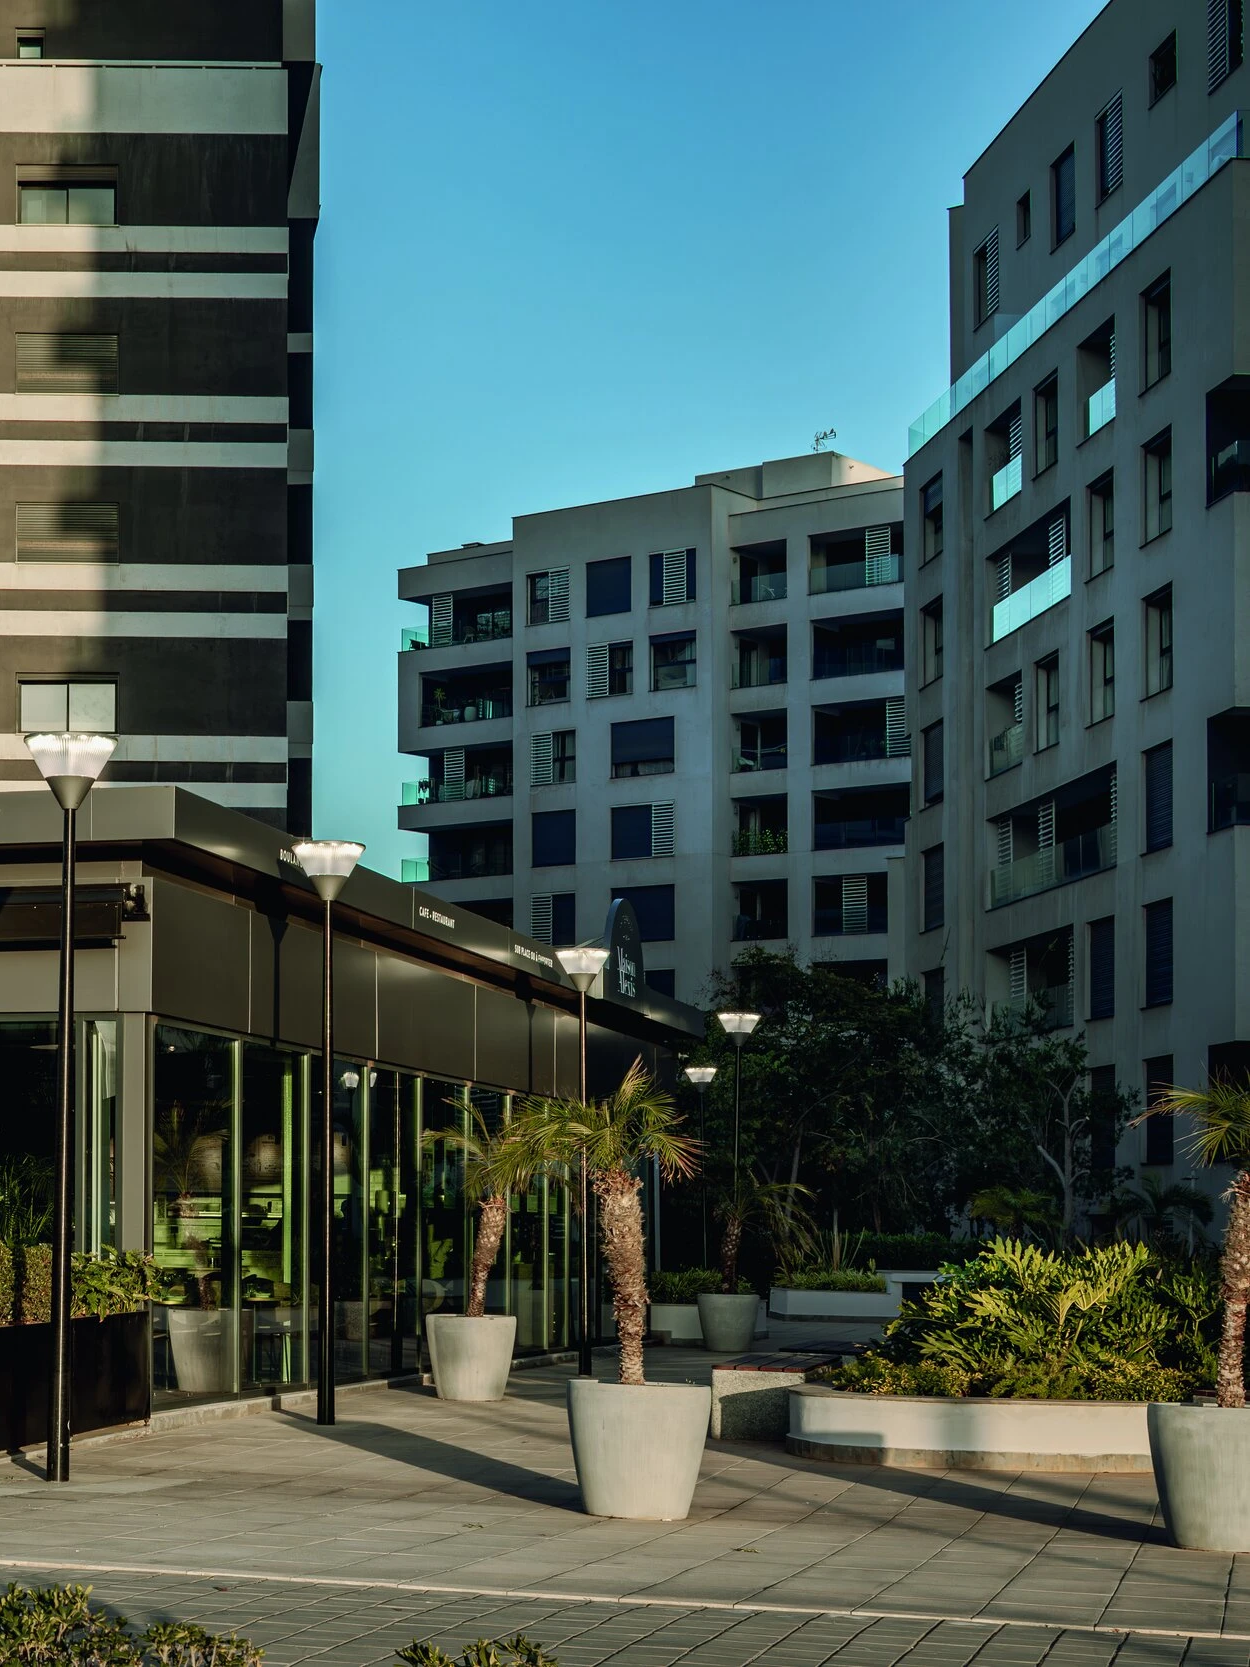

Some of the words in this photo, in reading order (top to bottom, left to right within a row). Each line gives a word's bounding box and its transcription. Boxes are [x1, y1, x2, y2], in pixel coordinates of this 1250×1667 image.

[419, 906, 430, 919] CAFE
[617, 945, 636, 977] Maison
[617, 970, 636, 998] Alexis
